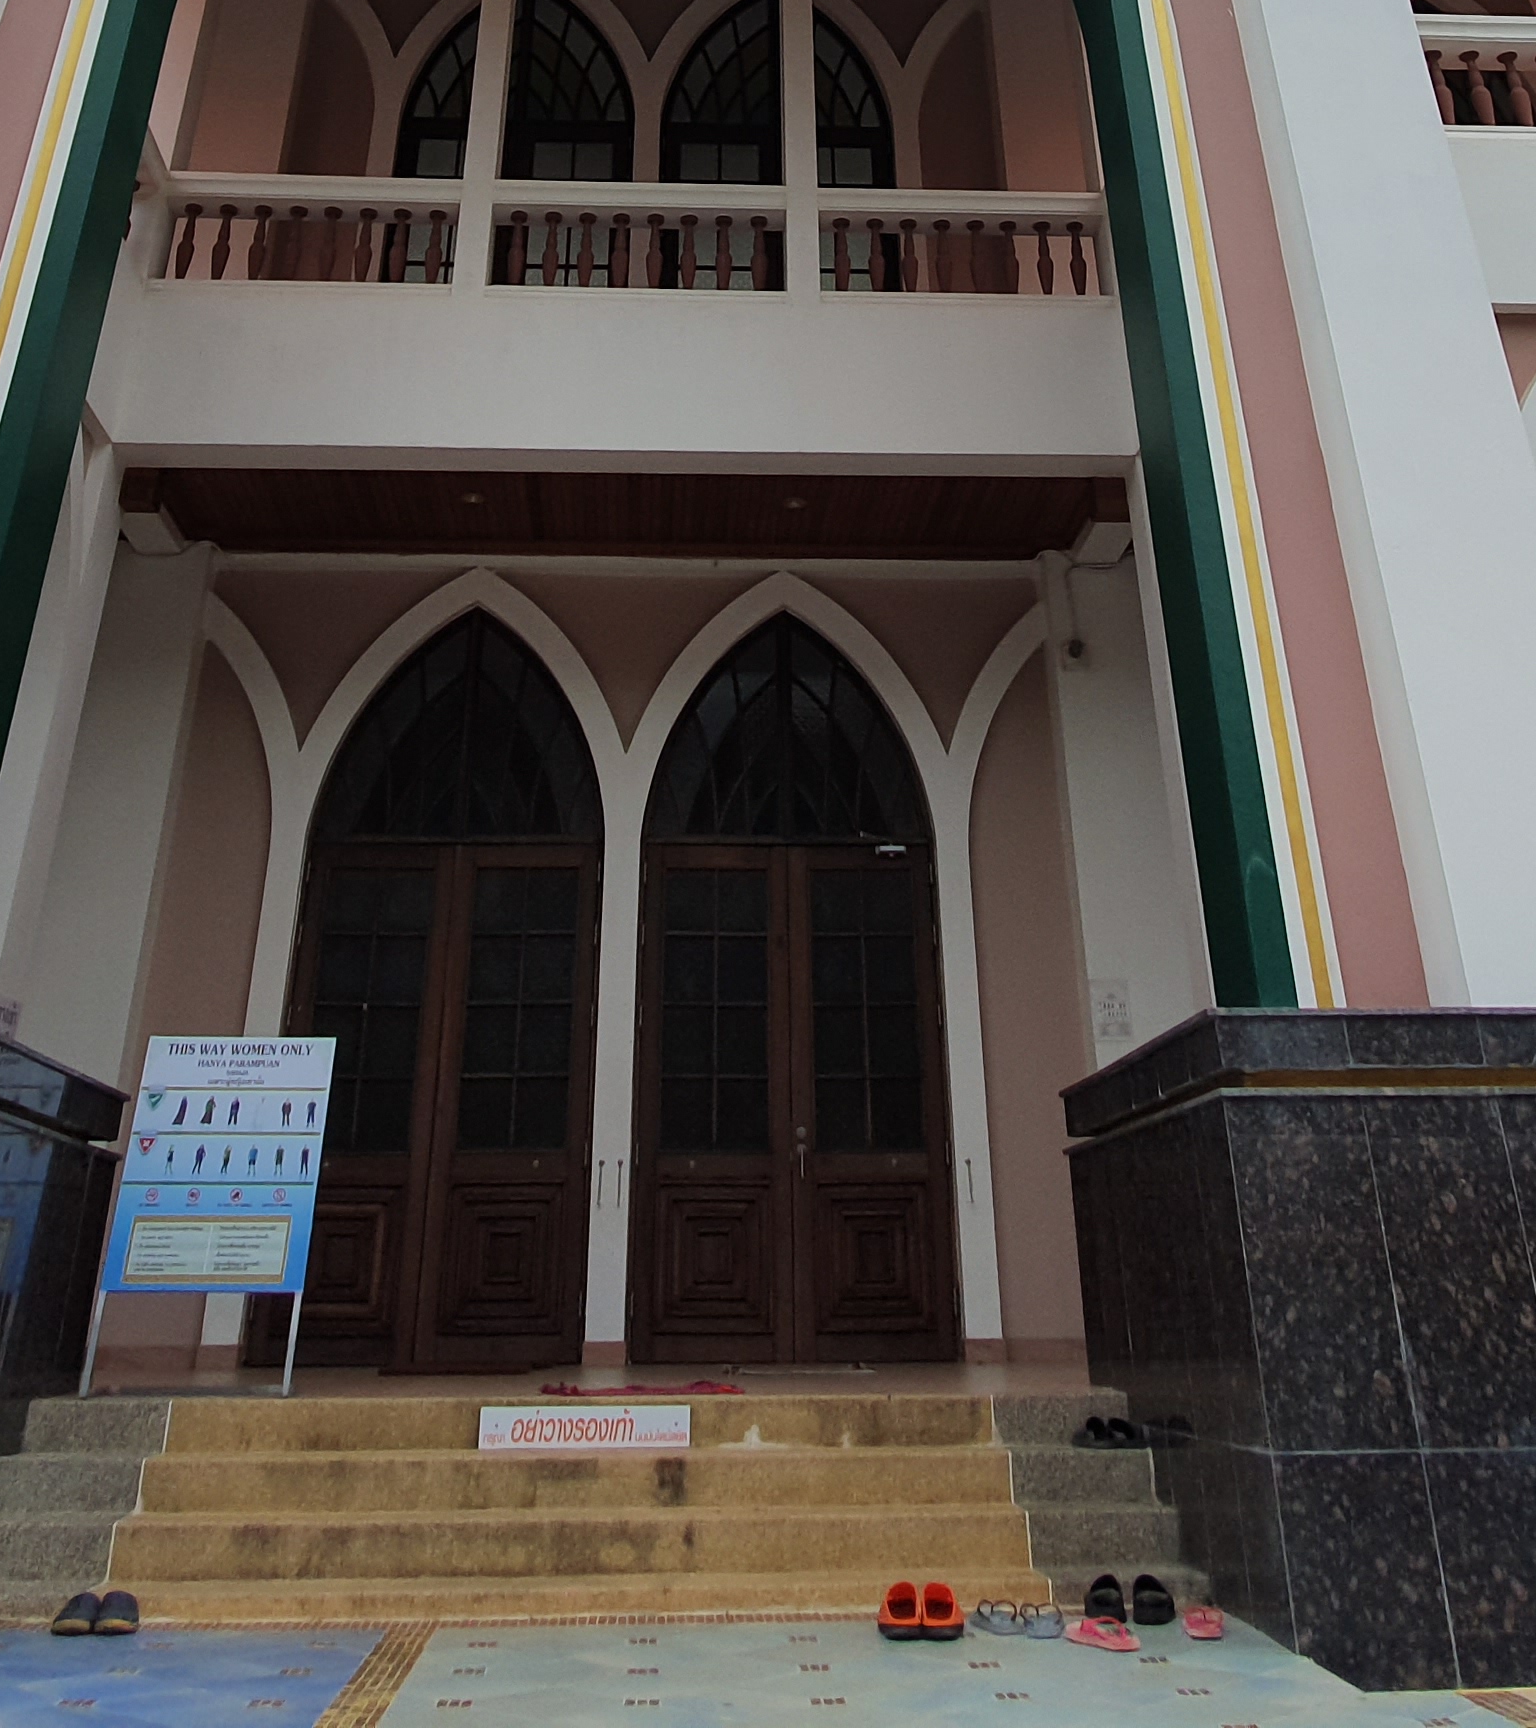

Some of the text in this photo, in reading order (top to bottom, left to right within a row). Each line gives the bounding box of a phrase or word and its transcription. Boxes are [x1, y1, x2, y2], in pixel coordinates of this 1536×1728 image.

[169, 1044, 313, 1055] THIS WAY WOMEN ONLY
[510, 1408, 635, 1444] อย่าวางรองเท้า
